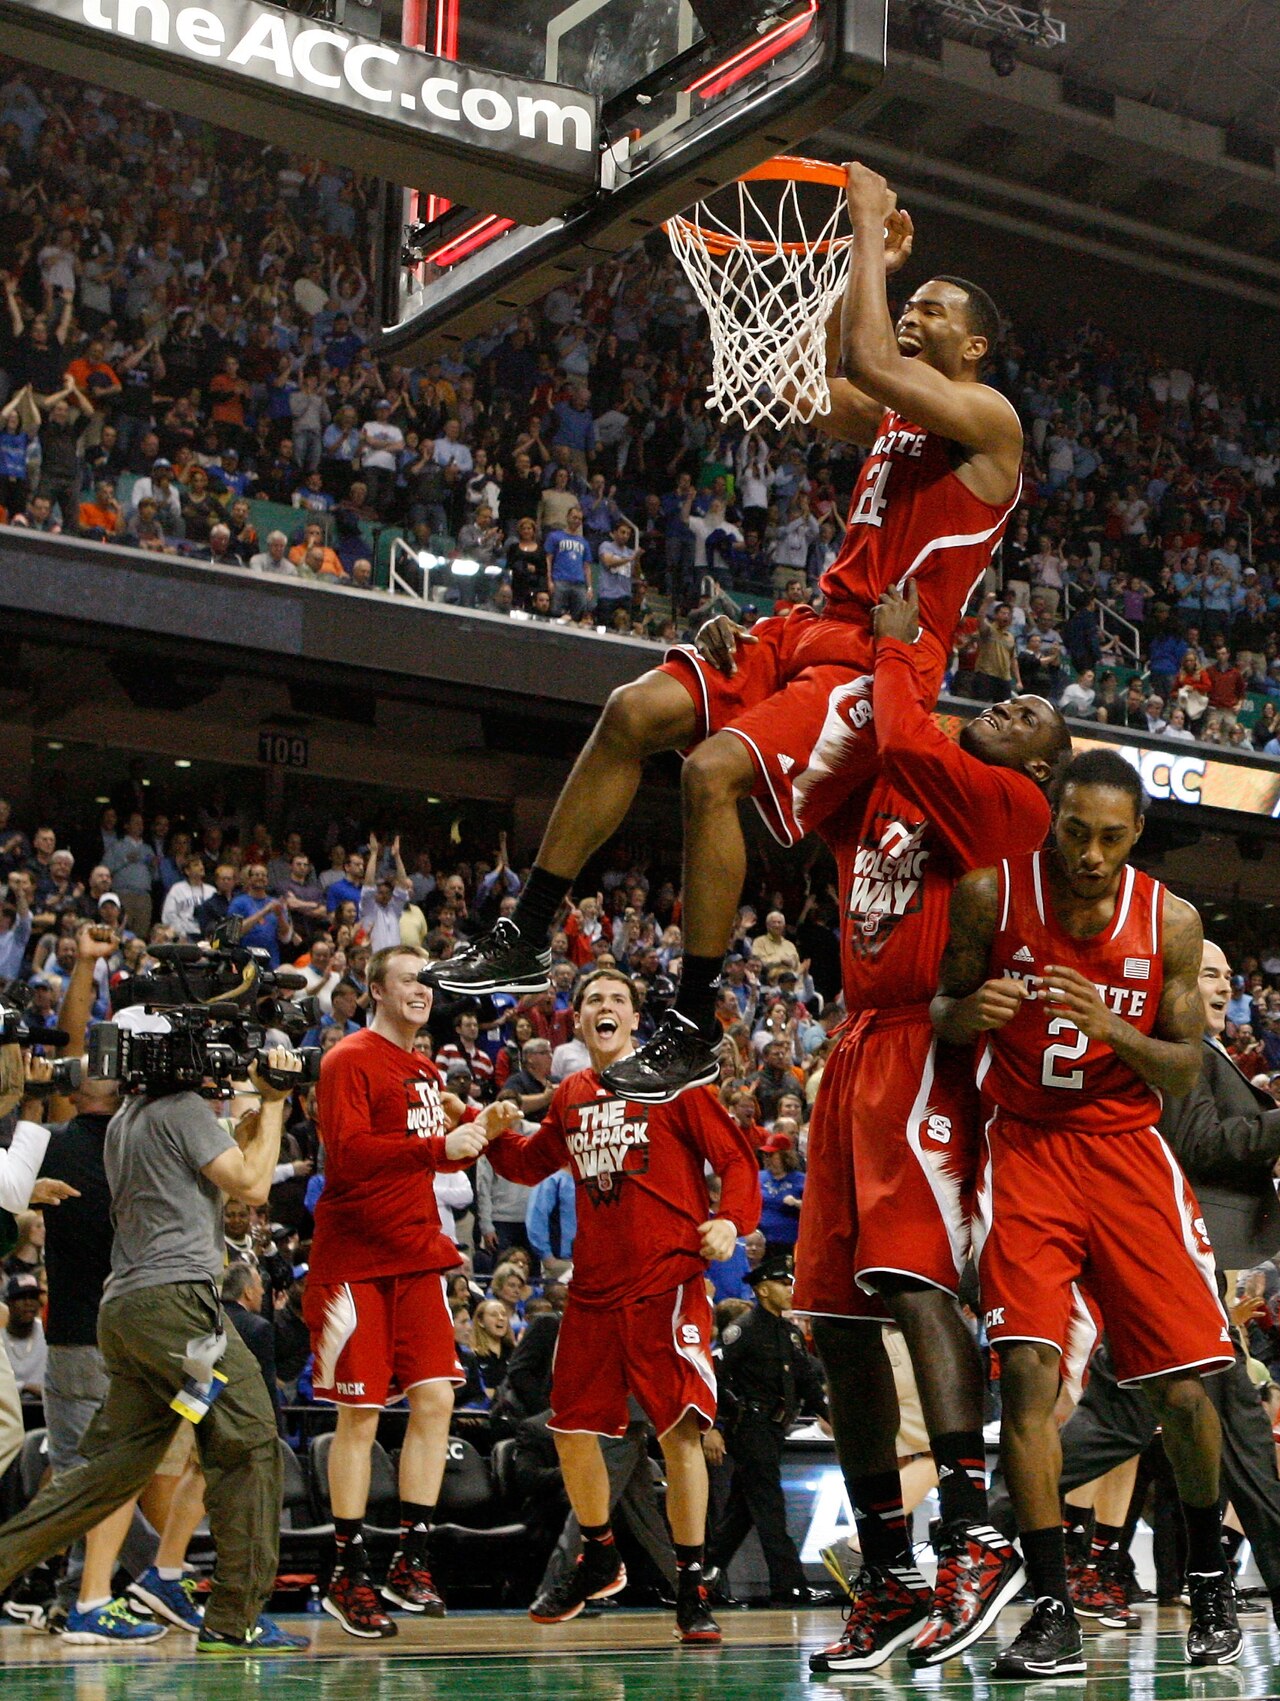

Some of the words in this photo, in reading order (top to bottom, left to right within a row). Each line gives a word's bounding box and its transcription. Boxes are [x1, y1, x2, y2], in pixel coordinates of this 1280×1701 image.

[81, 0, 592, 152] theACC.com
[260, 736, 305, 766] 109
[850, 876, 919, 915] WAY
[1041, 1017, 1089, 1090] 2
[415, 1080, 440, 1108] TH
[577, 1099, 627, 1132] THE
[565, 1122, 650, 1153] WOLFPACK
[574, 1145, 629, 1180] WAY
[985, 1307, 1005, 1329] CK
[335, 1381, 366, 1396] PACK
